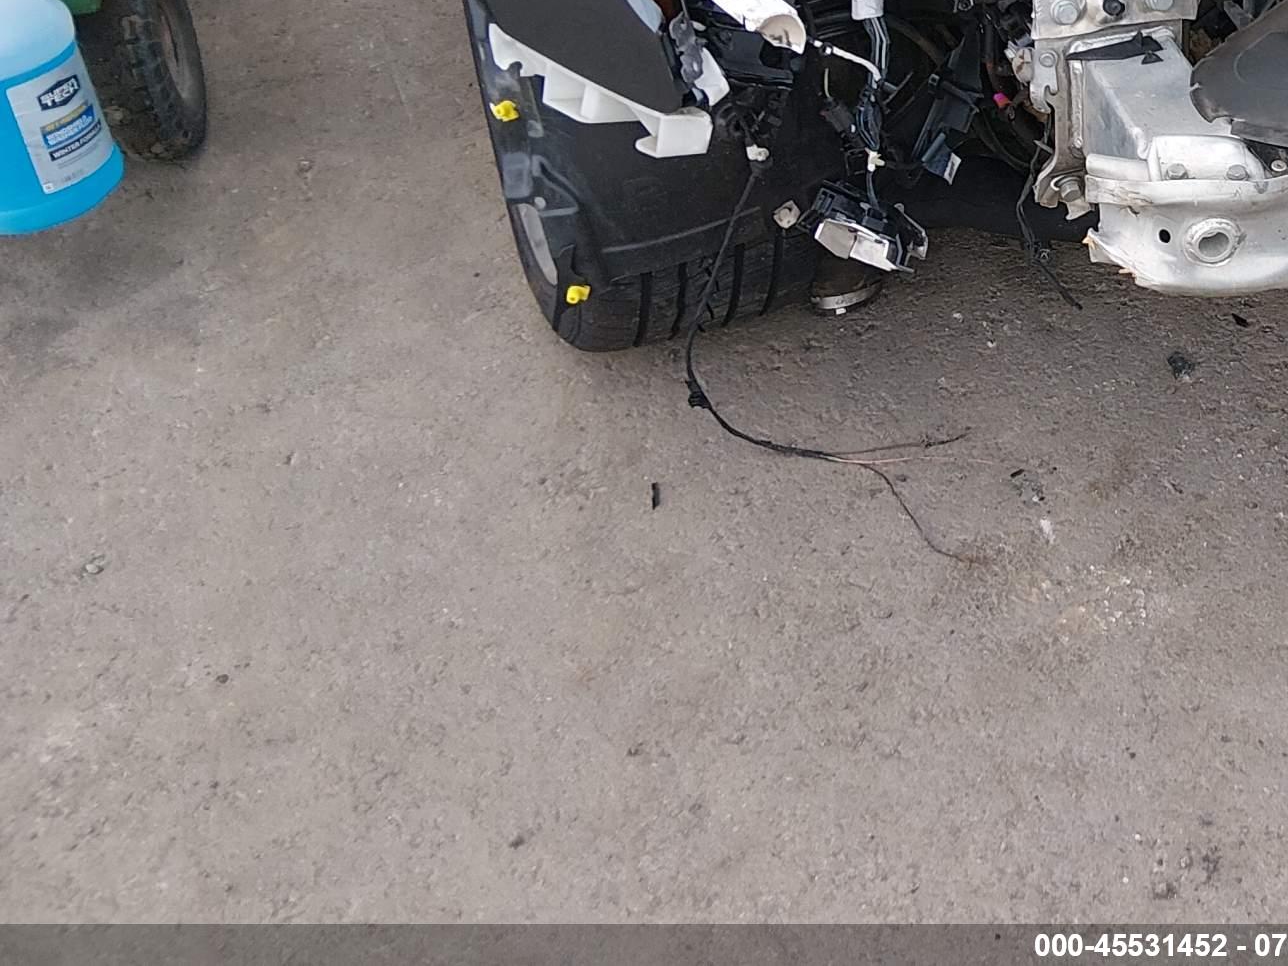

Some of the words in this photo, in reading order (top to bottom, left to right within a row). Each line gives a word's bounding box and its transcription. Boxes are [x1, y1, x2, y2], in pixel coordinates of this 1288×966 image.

[40, 78, 78, 104] SUPER
[46, 84, 78, 107] TECH
[52, 141, 81, 159] WINTER
